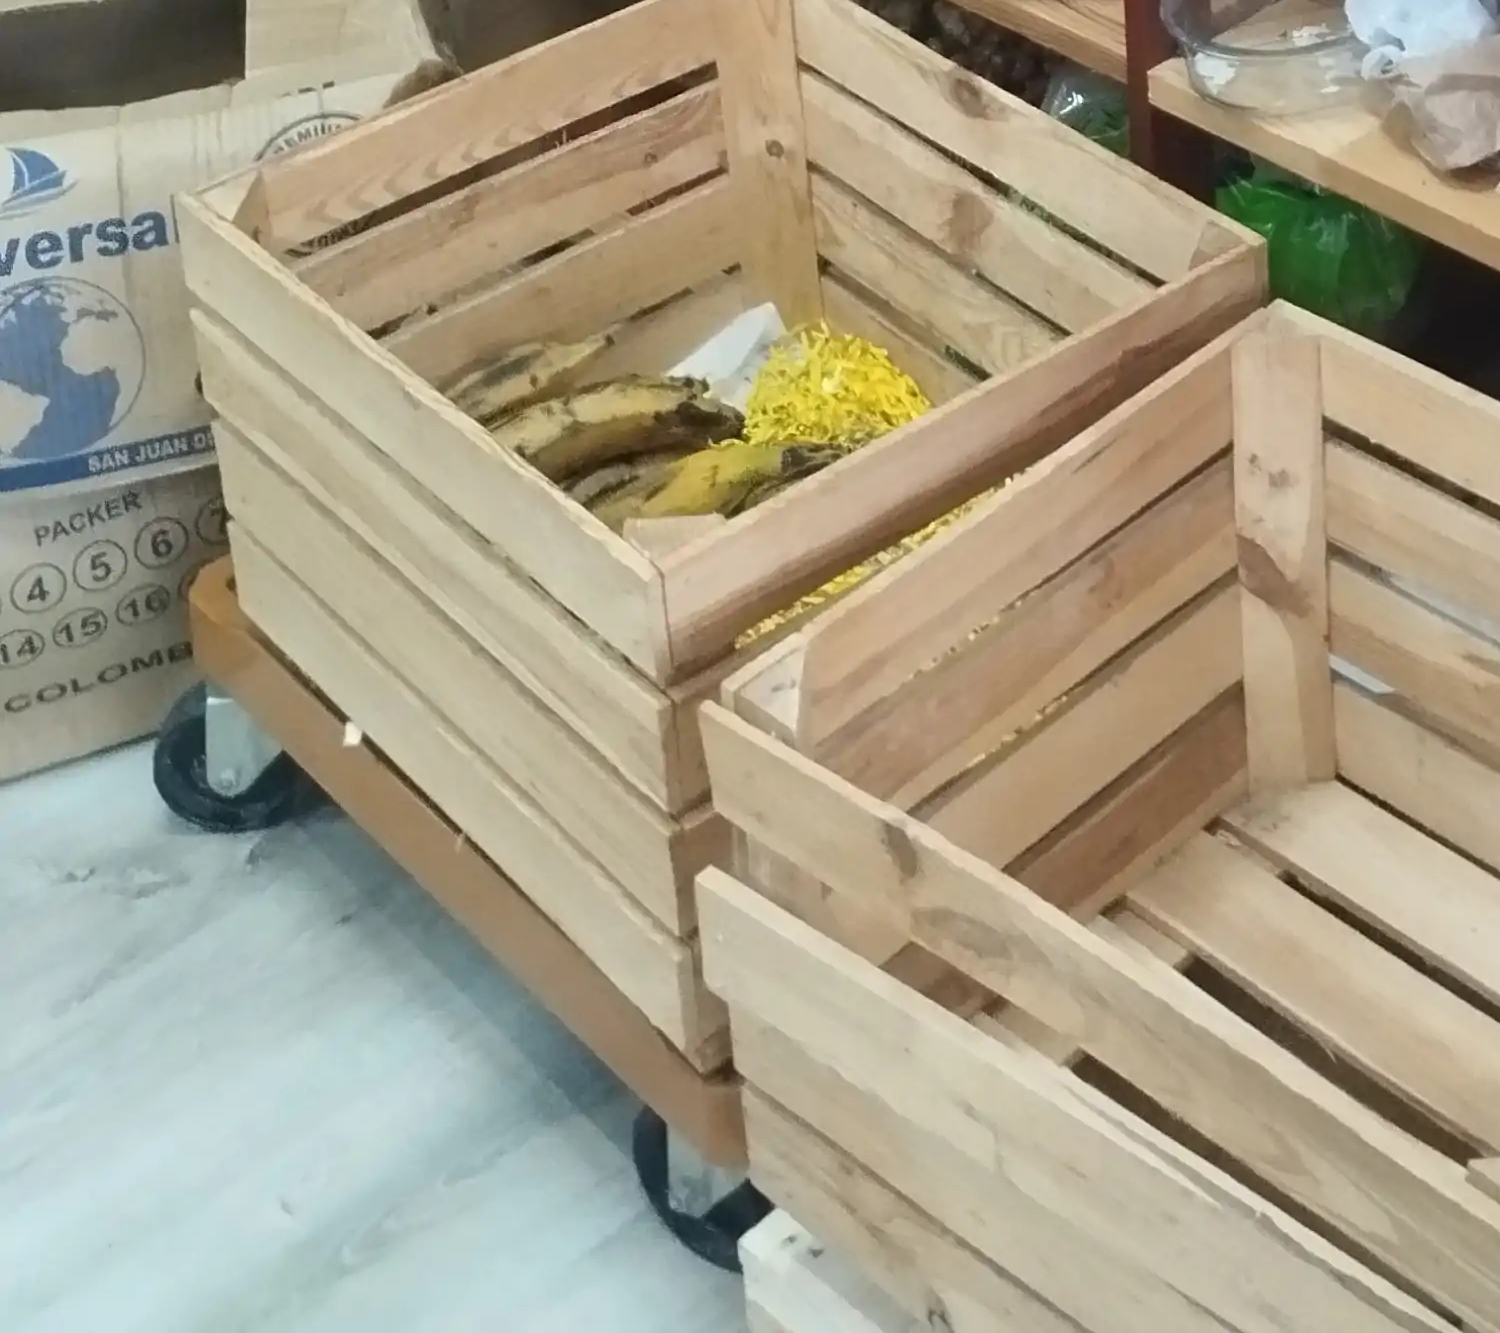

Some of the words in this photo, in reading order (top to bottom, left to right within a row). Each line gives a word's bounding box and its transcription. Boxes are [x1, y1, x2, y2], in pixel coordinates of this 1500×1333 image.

[88, 448, 131, 475] SAN
[134, 436, 189, 464] JUAN
[33, 488, 143, 548] PACKER
[27, 575, 49, 603] 4
[89, 551, 112, 583] 5
[150, 529, 174, 559] 6
[57, 613, 101, 644] 15
